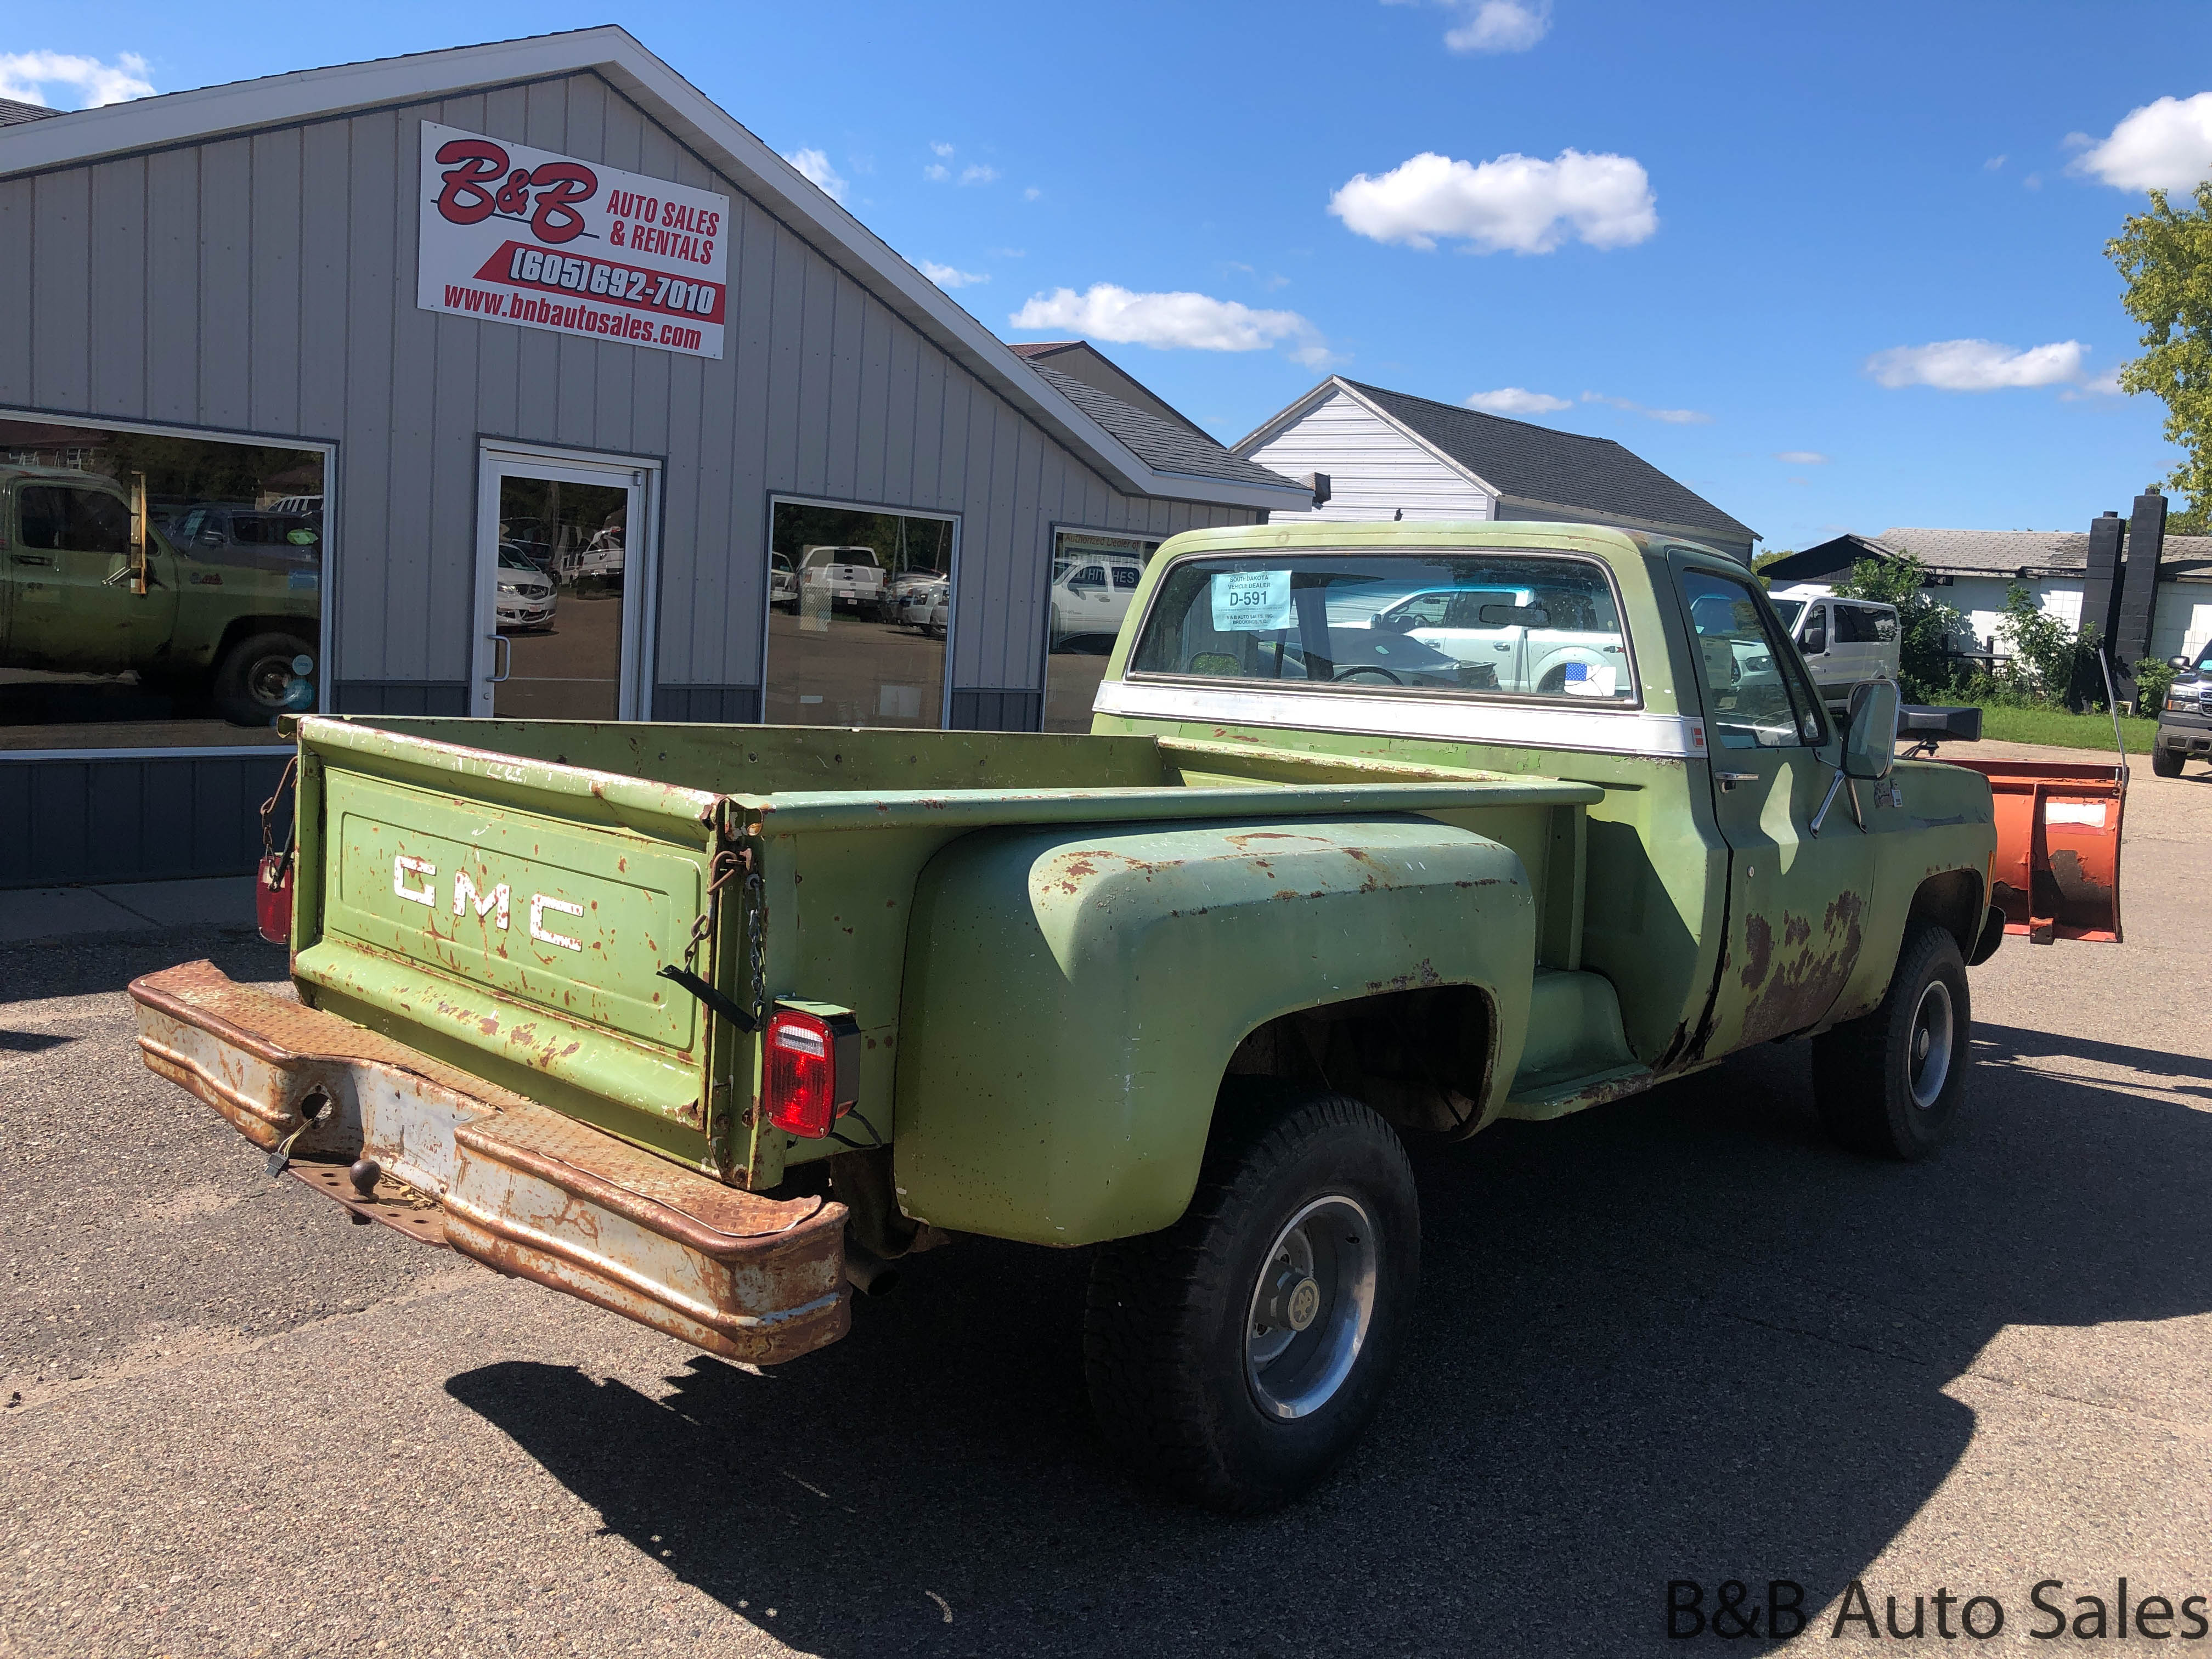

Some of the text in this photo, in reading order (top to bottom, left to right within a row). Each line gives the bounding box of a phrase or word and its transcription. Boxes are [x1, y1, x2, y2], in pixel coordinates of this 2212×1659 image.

[435, 139, 598, 245] B&B
[606, 189, 720, 237] AUTO SALES
[610, 220, 714, 266] & RENTALS
[509, 246, 717, 316] (605)692-7010
[444, 284, 702, 351] www.bnbautosales.com
[1065, 533, 1105, 546] Authorized
[1107, 538, 1130, 548] Dealer
[1229, 591, 1267, 606] D-591
[394, 855, 584, 952] GMC
